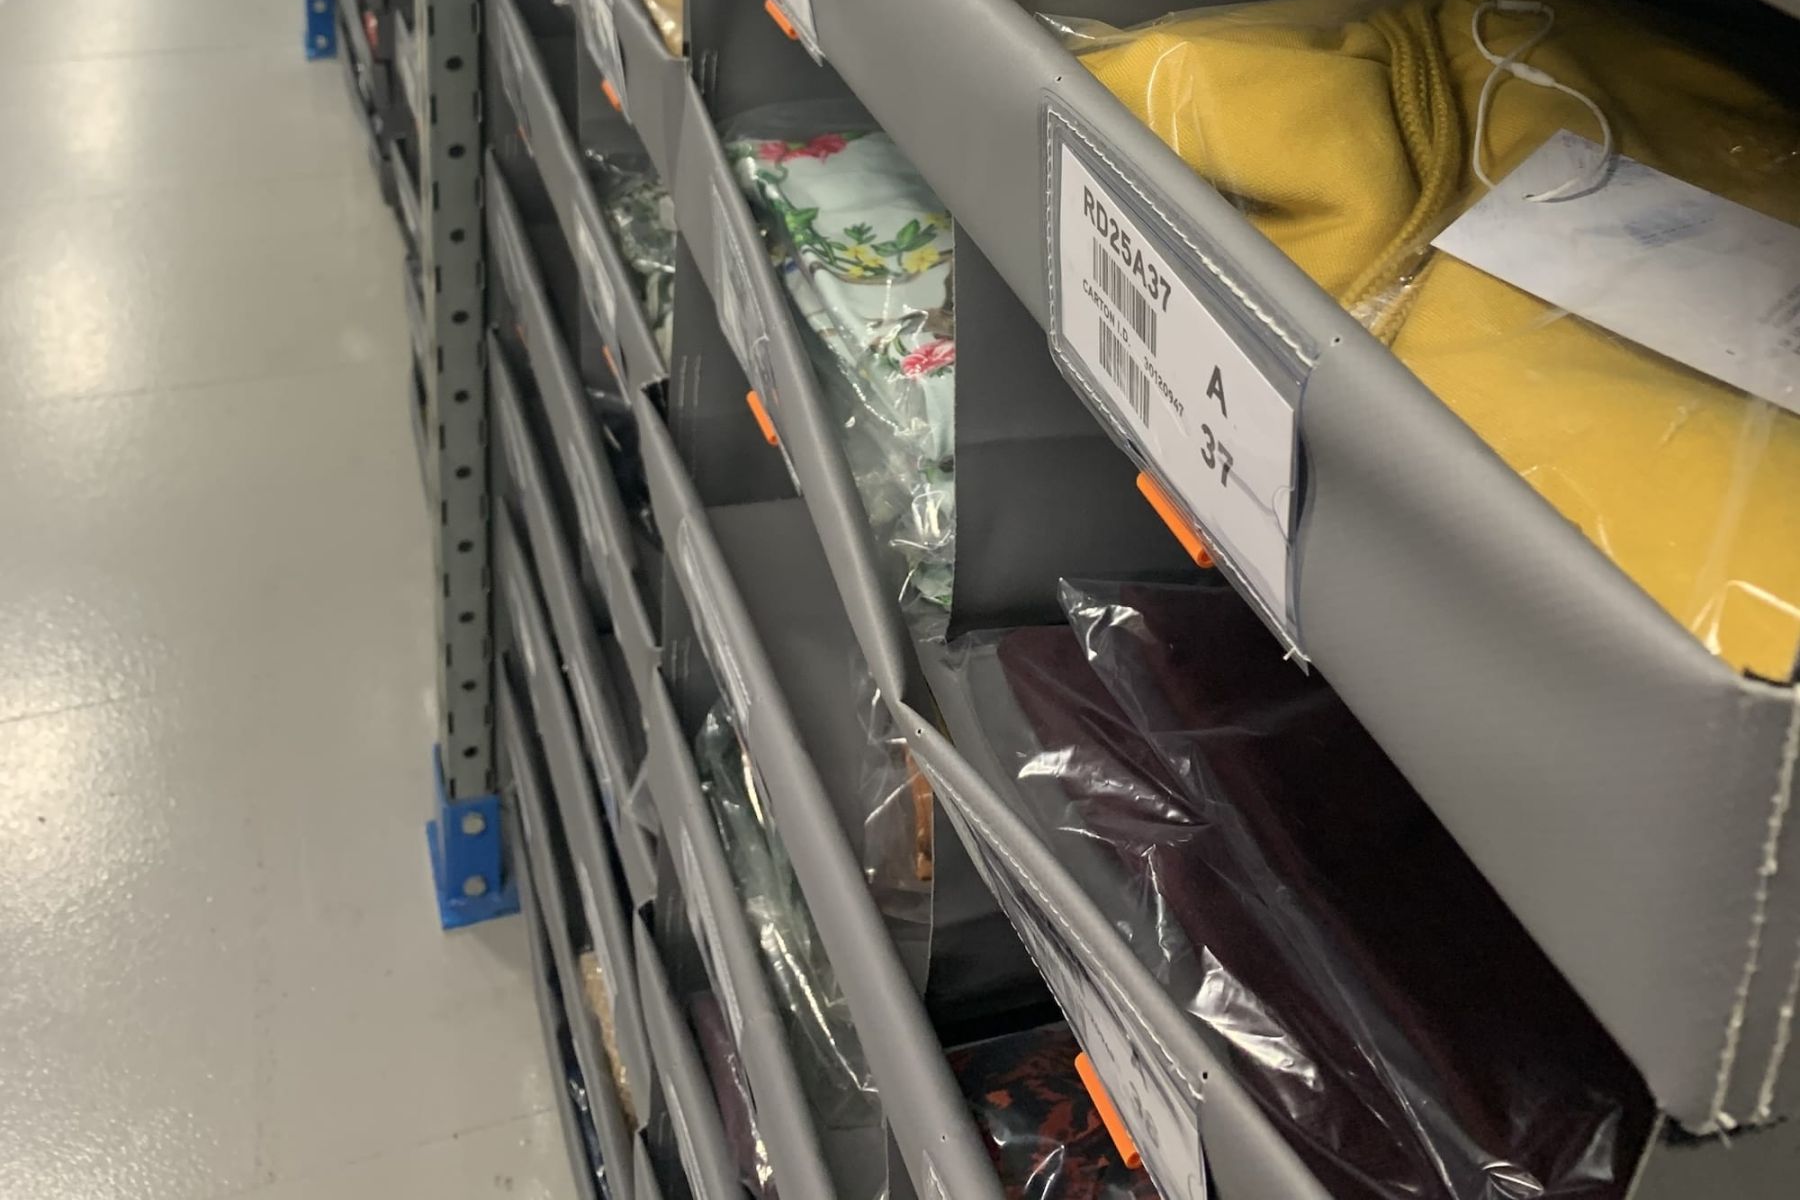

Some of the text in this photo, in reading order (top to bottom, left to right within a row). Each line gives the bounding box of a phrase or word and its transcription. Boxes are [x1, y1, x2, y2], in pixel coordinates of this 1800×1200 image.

[1082, 185, 1172, 313] RD25A37
[1082, 278, 1115, 325] CARTON
[1143, 355, 1185, 417] 30120947
[1206, 364, 1229, 419] A
[1200, 423, 1235, 488] 37
